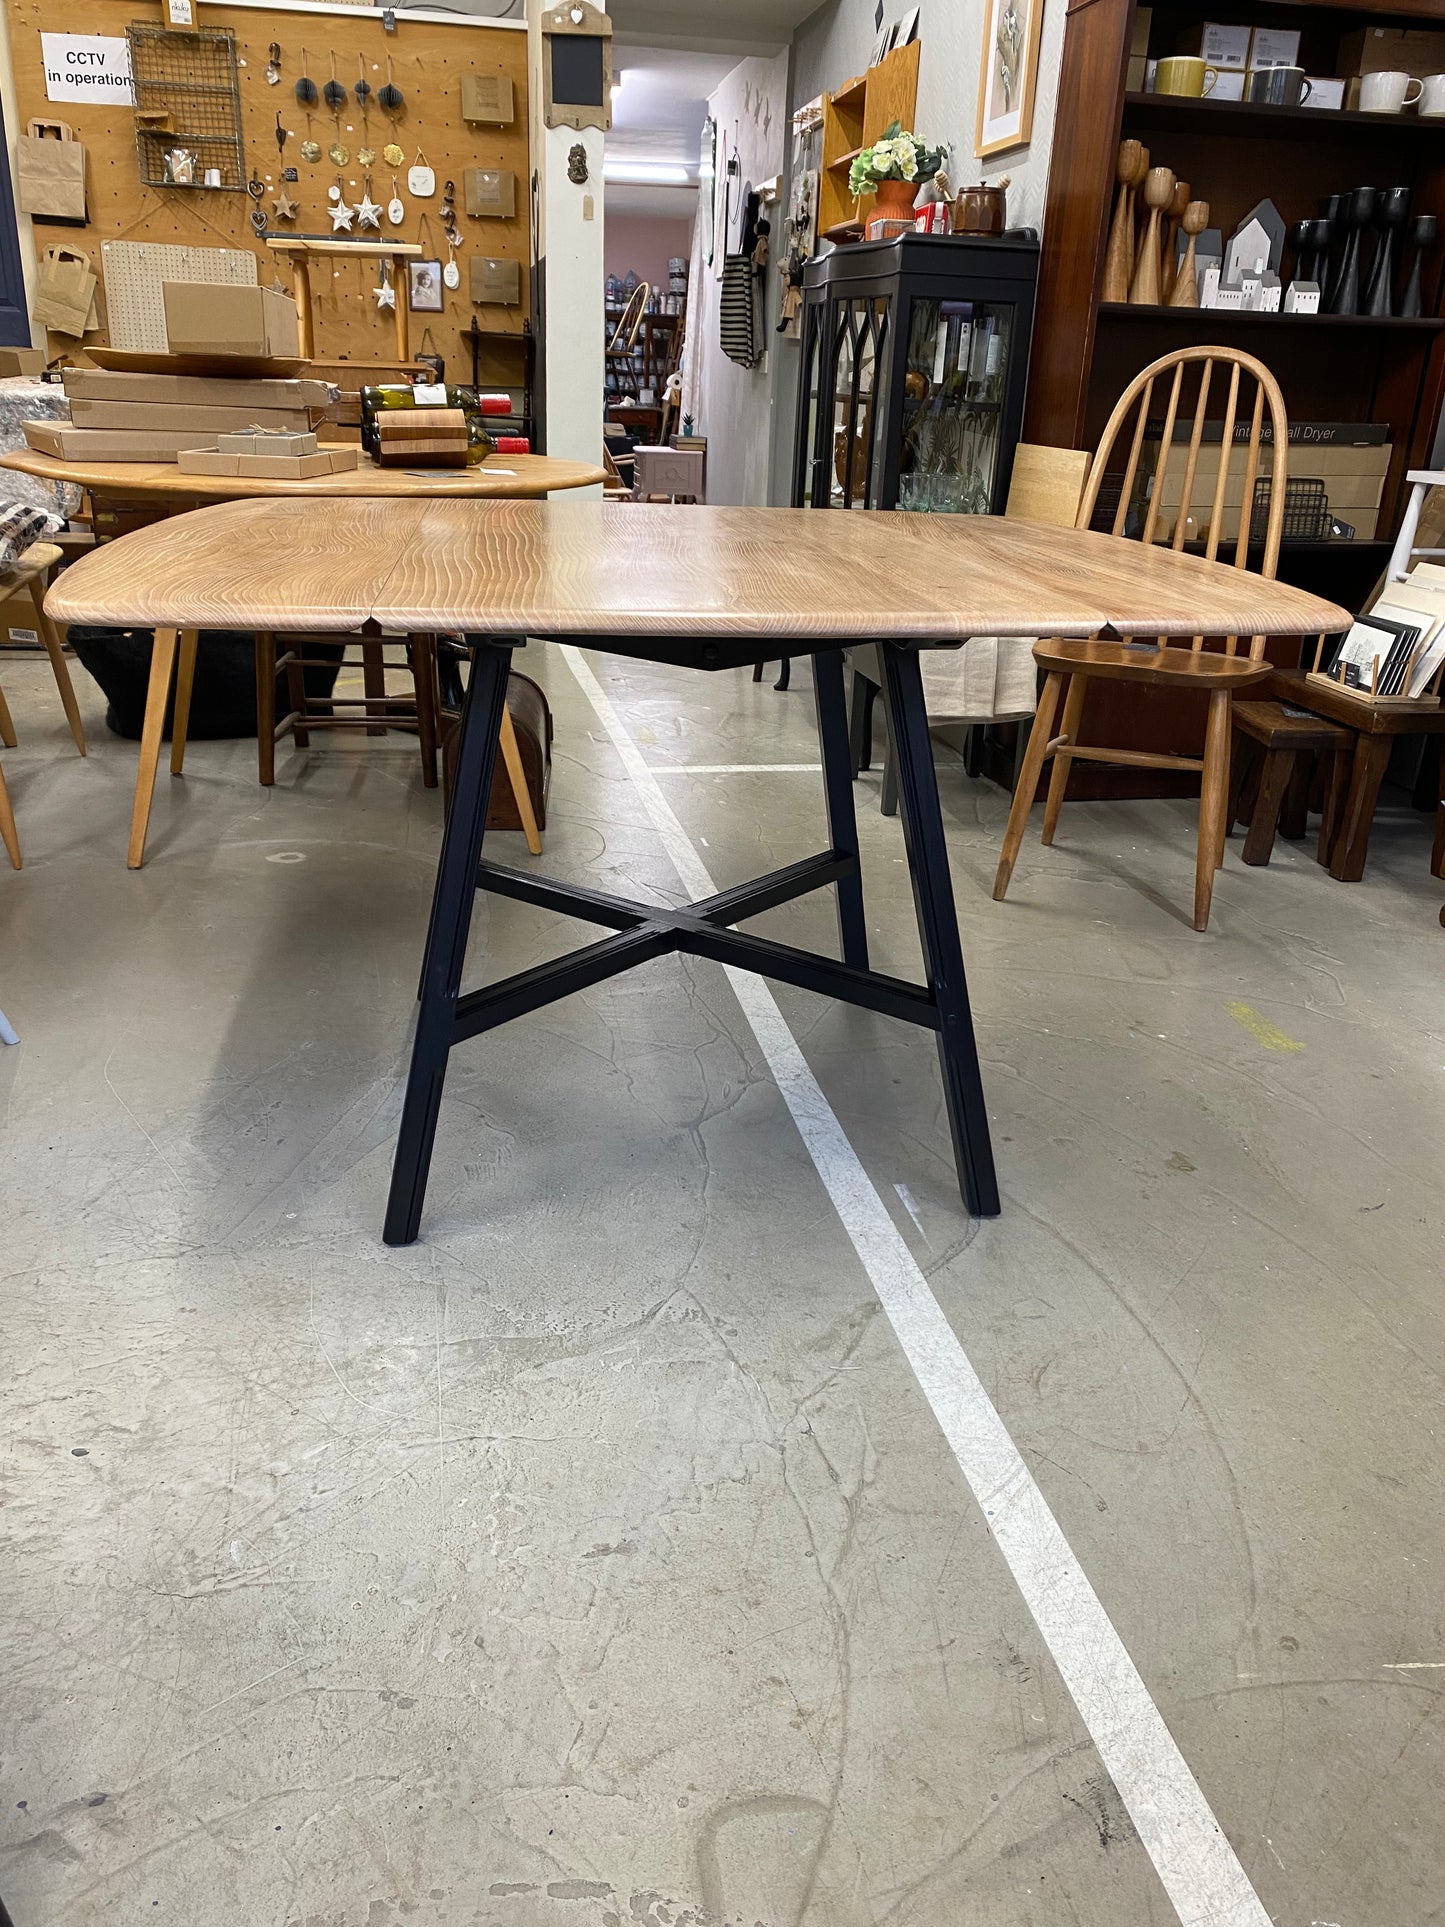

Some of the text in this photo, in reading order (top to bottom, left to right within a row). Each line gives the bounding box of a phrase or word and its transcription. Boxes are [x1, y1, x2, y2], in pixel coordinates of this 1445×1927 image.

[66, 51, 105, 66] CCTV
[48, 69, 132, 87] in operation
[1232, 425, 1272, 440] intge
[1303, 426, 1336, 442] Dryer
